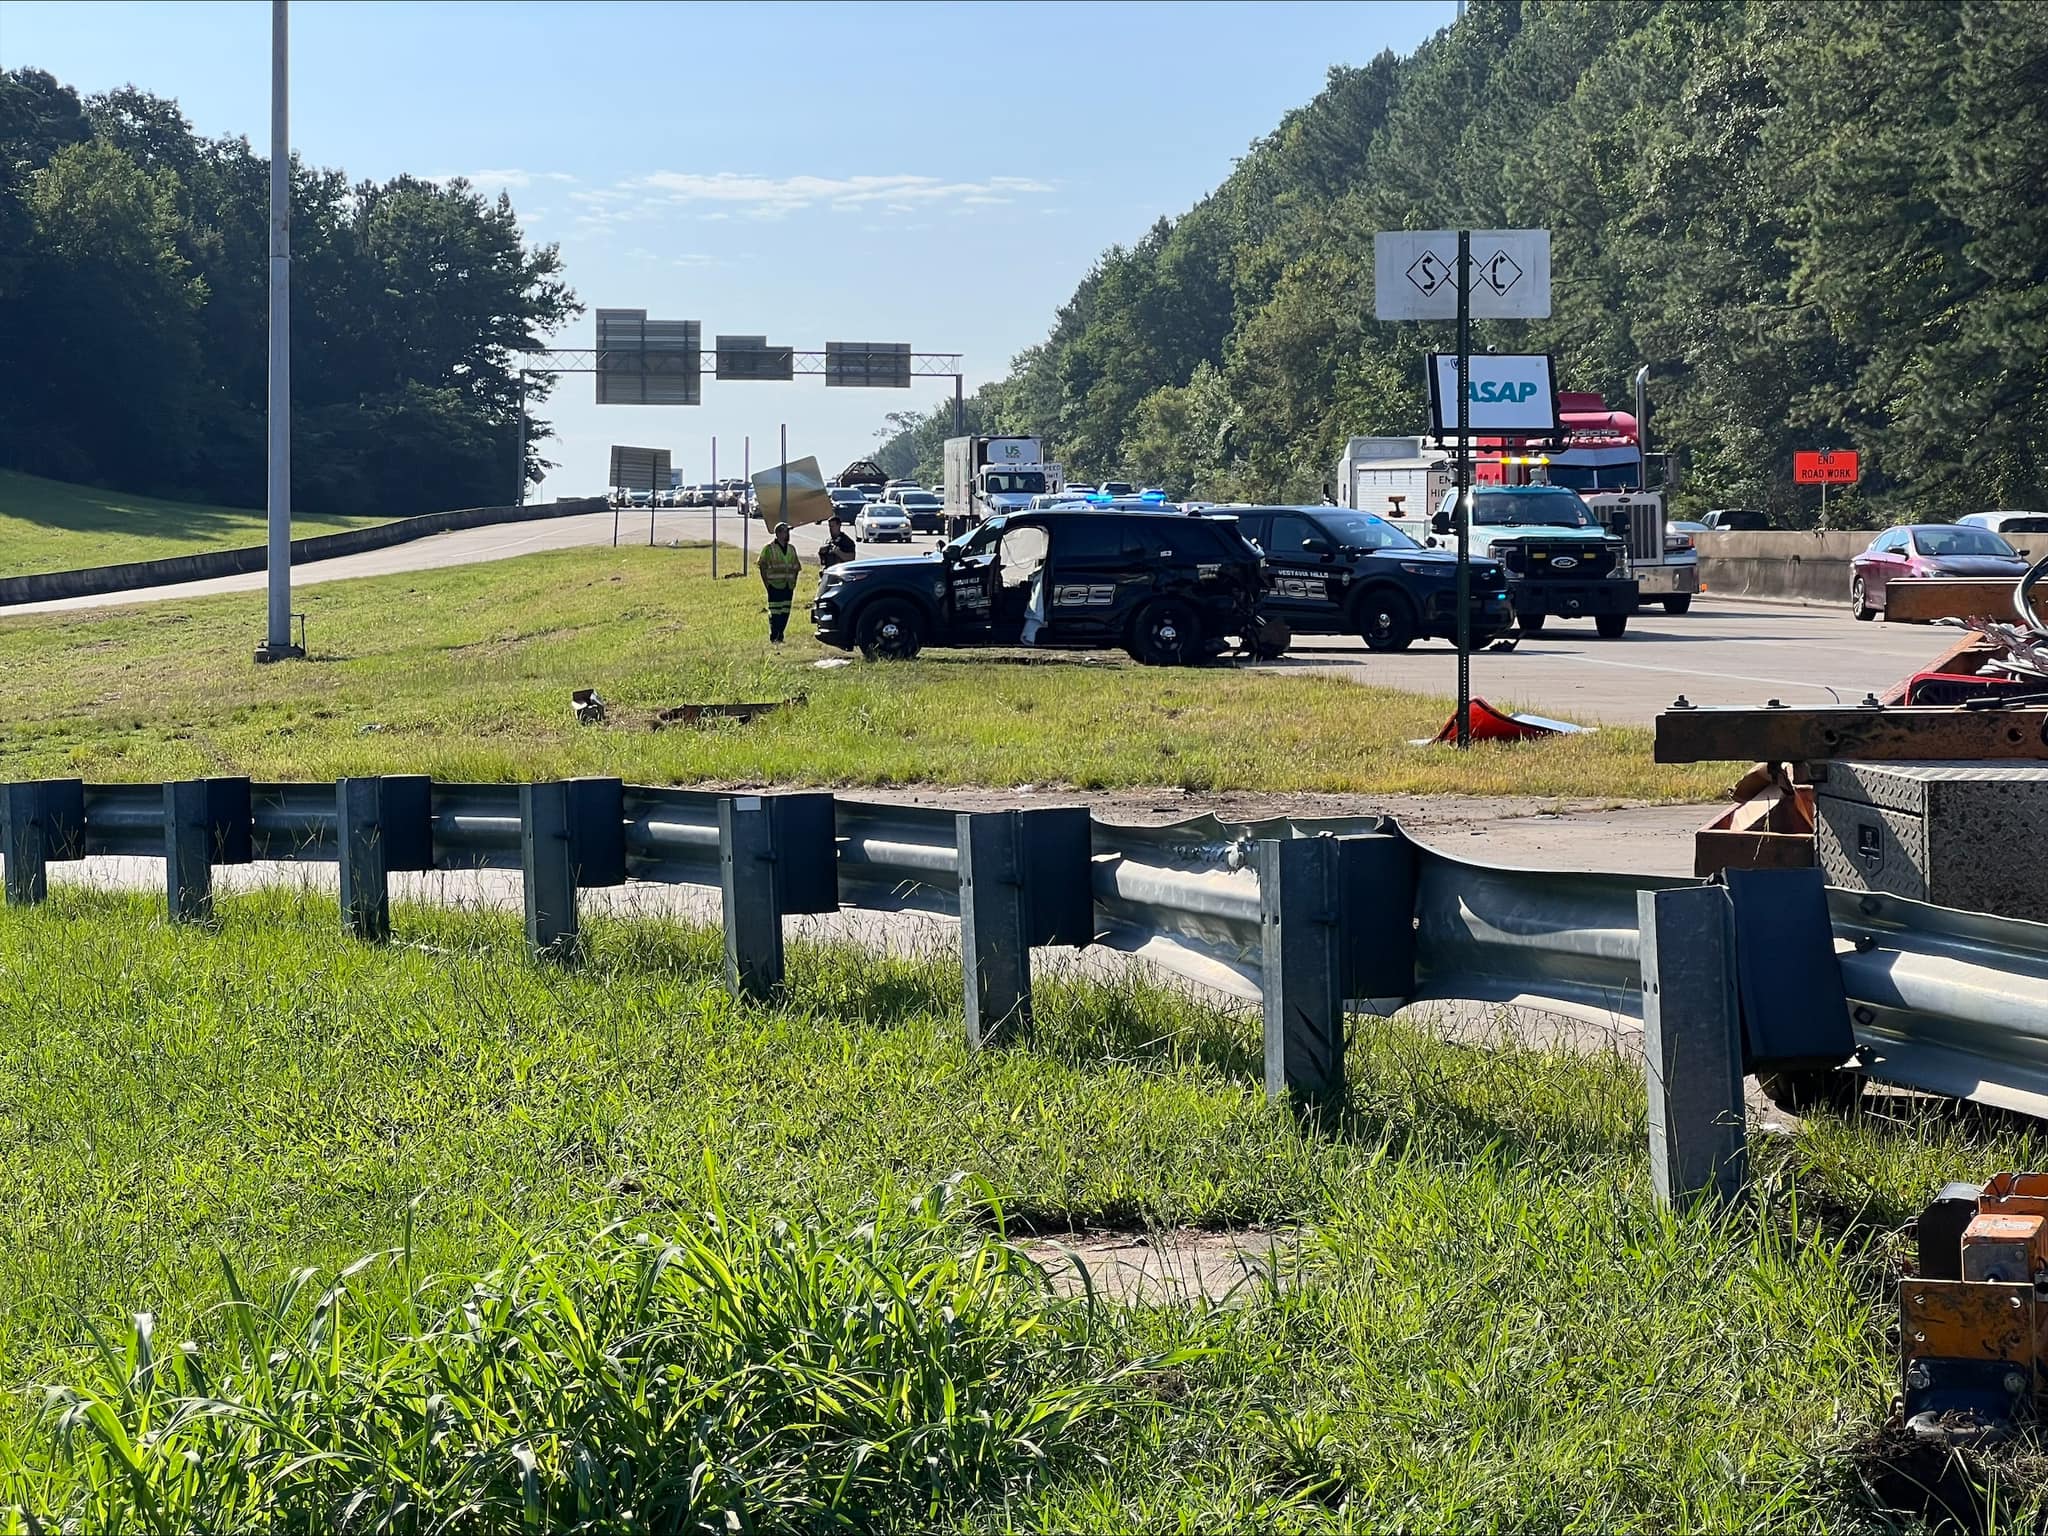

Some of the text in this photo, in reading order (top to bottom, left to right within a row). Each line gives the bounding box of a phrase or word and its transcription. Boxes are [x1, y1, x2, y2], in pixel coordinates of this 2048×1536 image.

[1468, 381, 1537, 402] ASAP
[1818, 456, 1835, 465] END
[1801, 469, 1851, 479] ROAD WORK
[1440, 475, 1451, 485] EN
[1431, 488, 1447, 498] HIG
